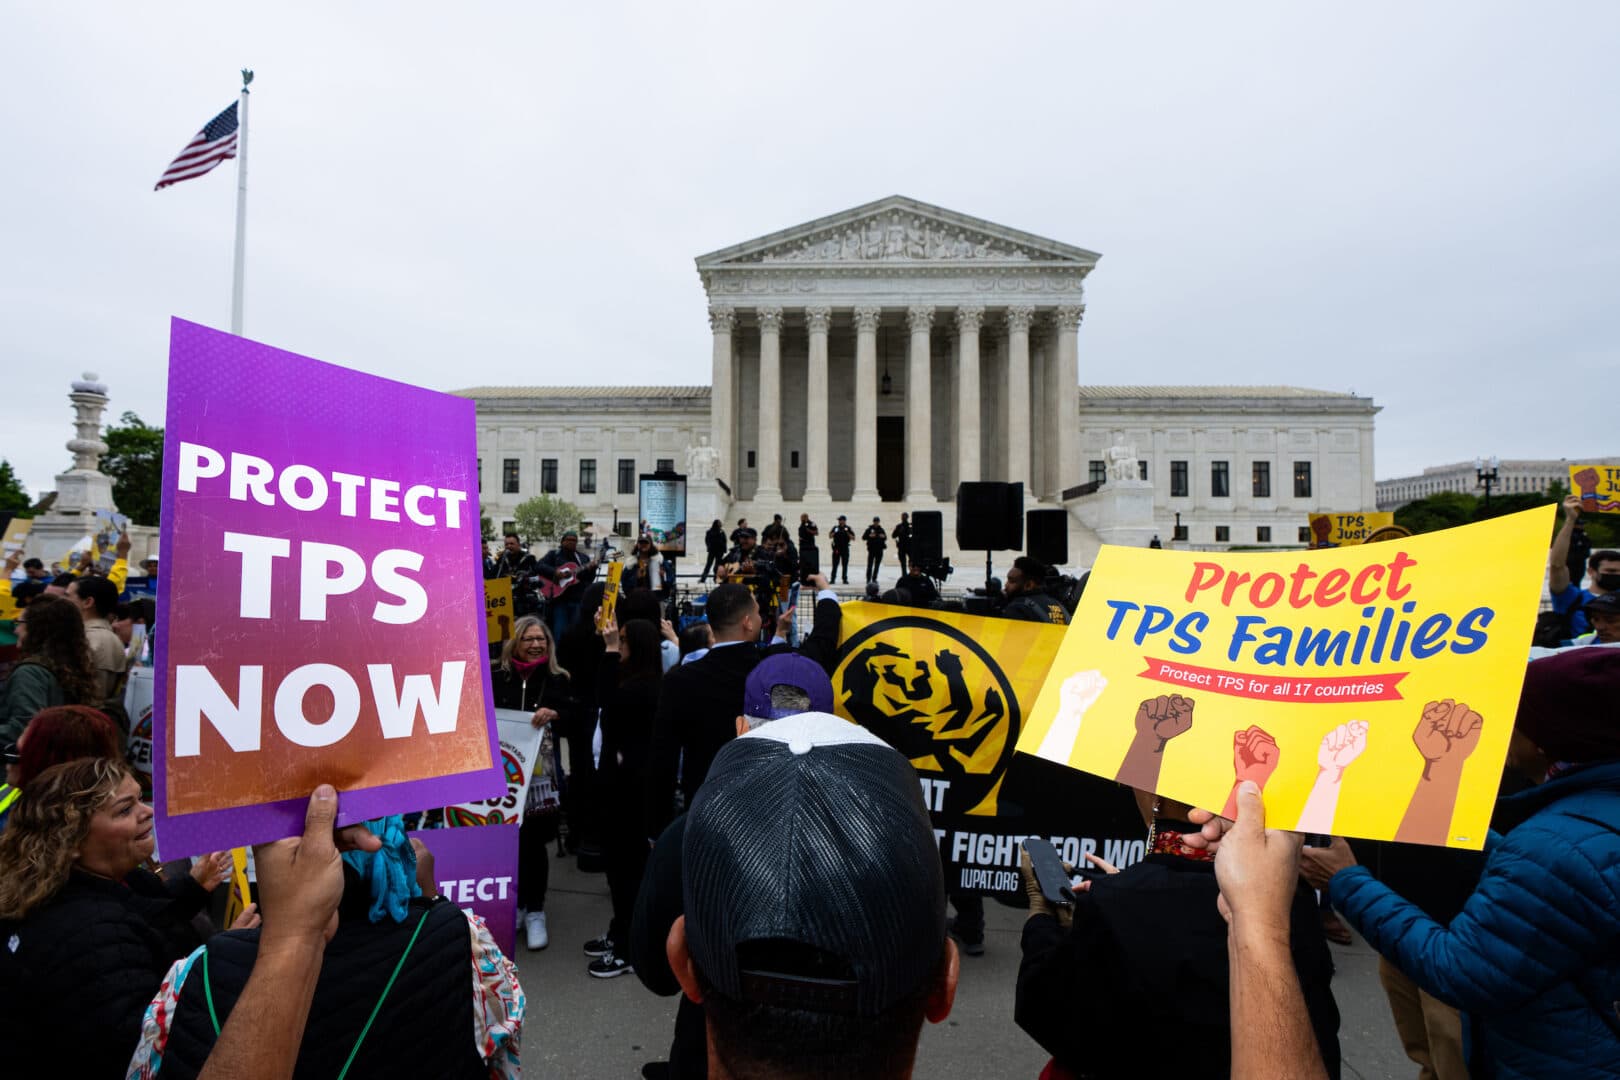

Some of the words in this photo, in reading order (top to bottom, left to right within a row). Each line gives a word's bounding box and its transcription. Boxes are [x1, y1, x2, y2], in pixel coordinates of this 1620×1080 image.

[178, 441, 467, 529] PROTECT
[1336, 515, 1365, 527] TPS
[1336, 526, 1373, 539] Justi
[224, 532, 428, 625] TPS
[1186, 552, 1418, 609] Protect
[1107, 600, 1209, 654] TPS
[1229, 601, 1494, 666] Families
[1159, 665, 1212, 686] Protect
[1217, 676, 1245, 691] TPS
[1248, 680, 1269, 694] for
[1273, 682, 1290, 696] all
[1294, 684, 1312, 697] 17
[1314, 682, 1384, 697] countries
[174, 661, 467, 757] NOW
[951, 831, 1042, 868] FIGHT
[1103, 838, 1146, 870] WO
[440, 876, 512, 903] TECT
[961, 868, 1019, 892] IUPAT.ORG
